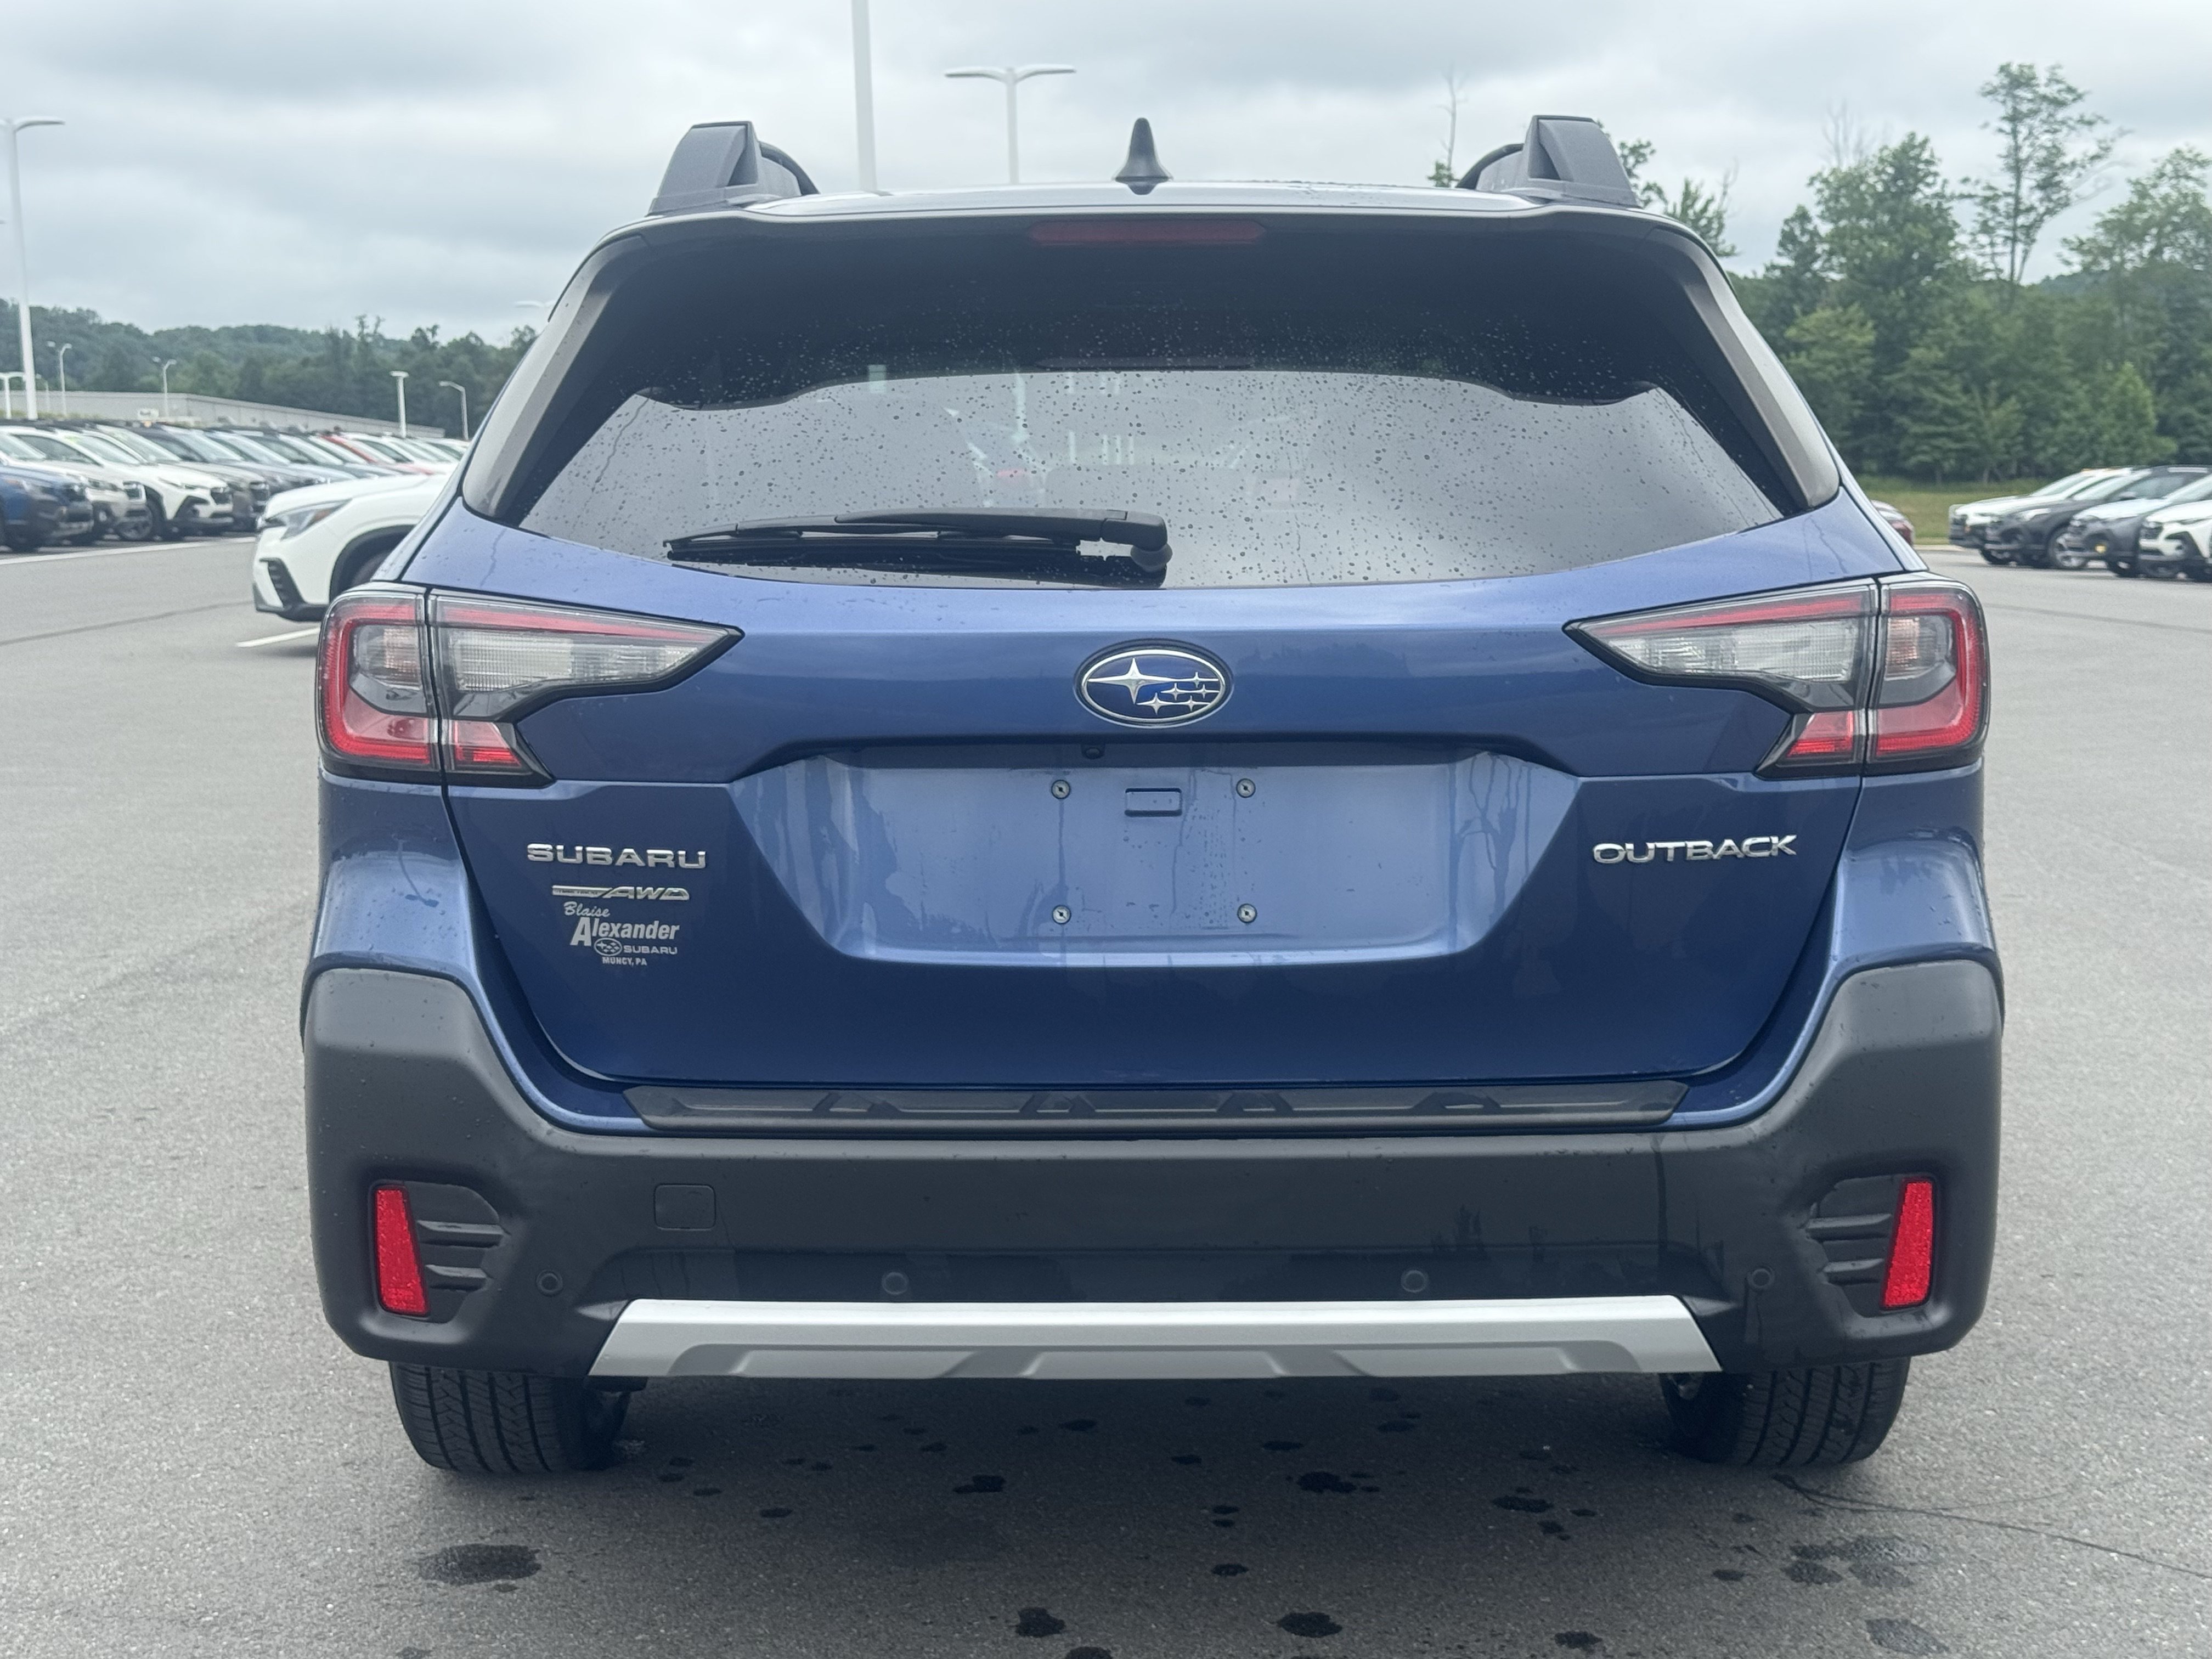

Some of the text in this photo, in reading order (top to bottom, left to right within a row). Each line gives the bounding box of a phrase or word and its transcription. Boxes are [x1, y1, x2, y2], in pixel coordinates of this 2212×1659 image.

[527, 843, 707, 869] SUBARU
[1593, 834, 1797, 864] OUTBACK
[602, 885, 690, 901] AWD
[563, 901, 611, 917] Blaise
[570, 917, 680, 946] Alexander
[623, 945, 678, 955] SUBARU
